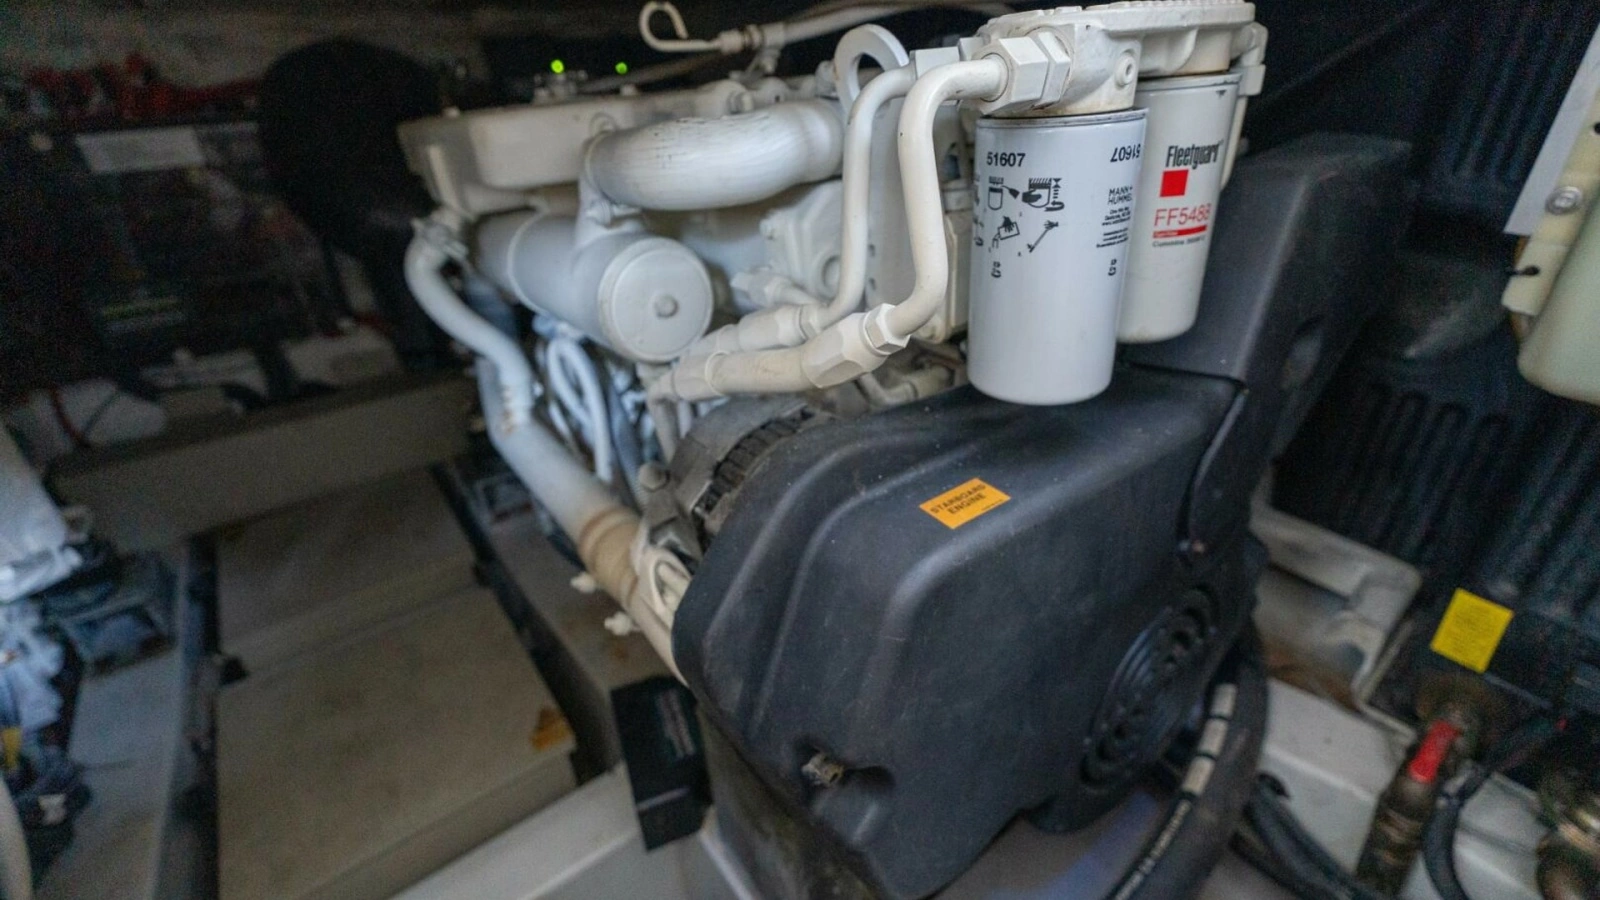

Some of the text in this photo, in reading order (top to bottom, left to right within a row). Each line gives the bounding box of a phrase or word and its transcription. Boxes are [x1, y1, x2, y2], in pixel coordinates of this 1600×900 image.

[986, 151, 1026, 167] 51607
[930, 484, 986, 514] STARBOARD
[948, 492, 986, 514] ENGINE
